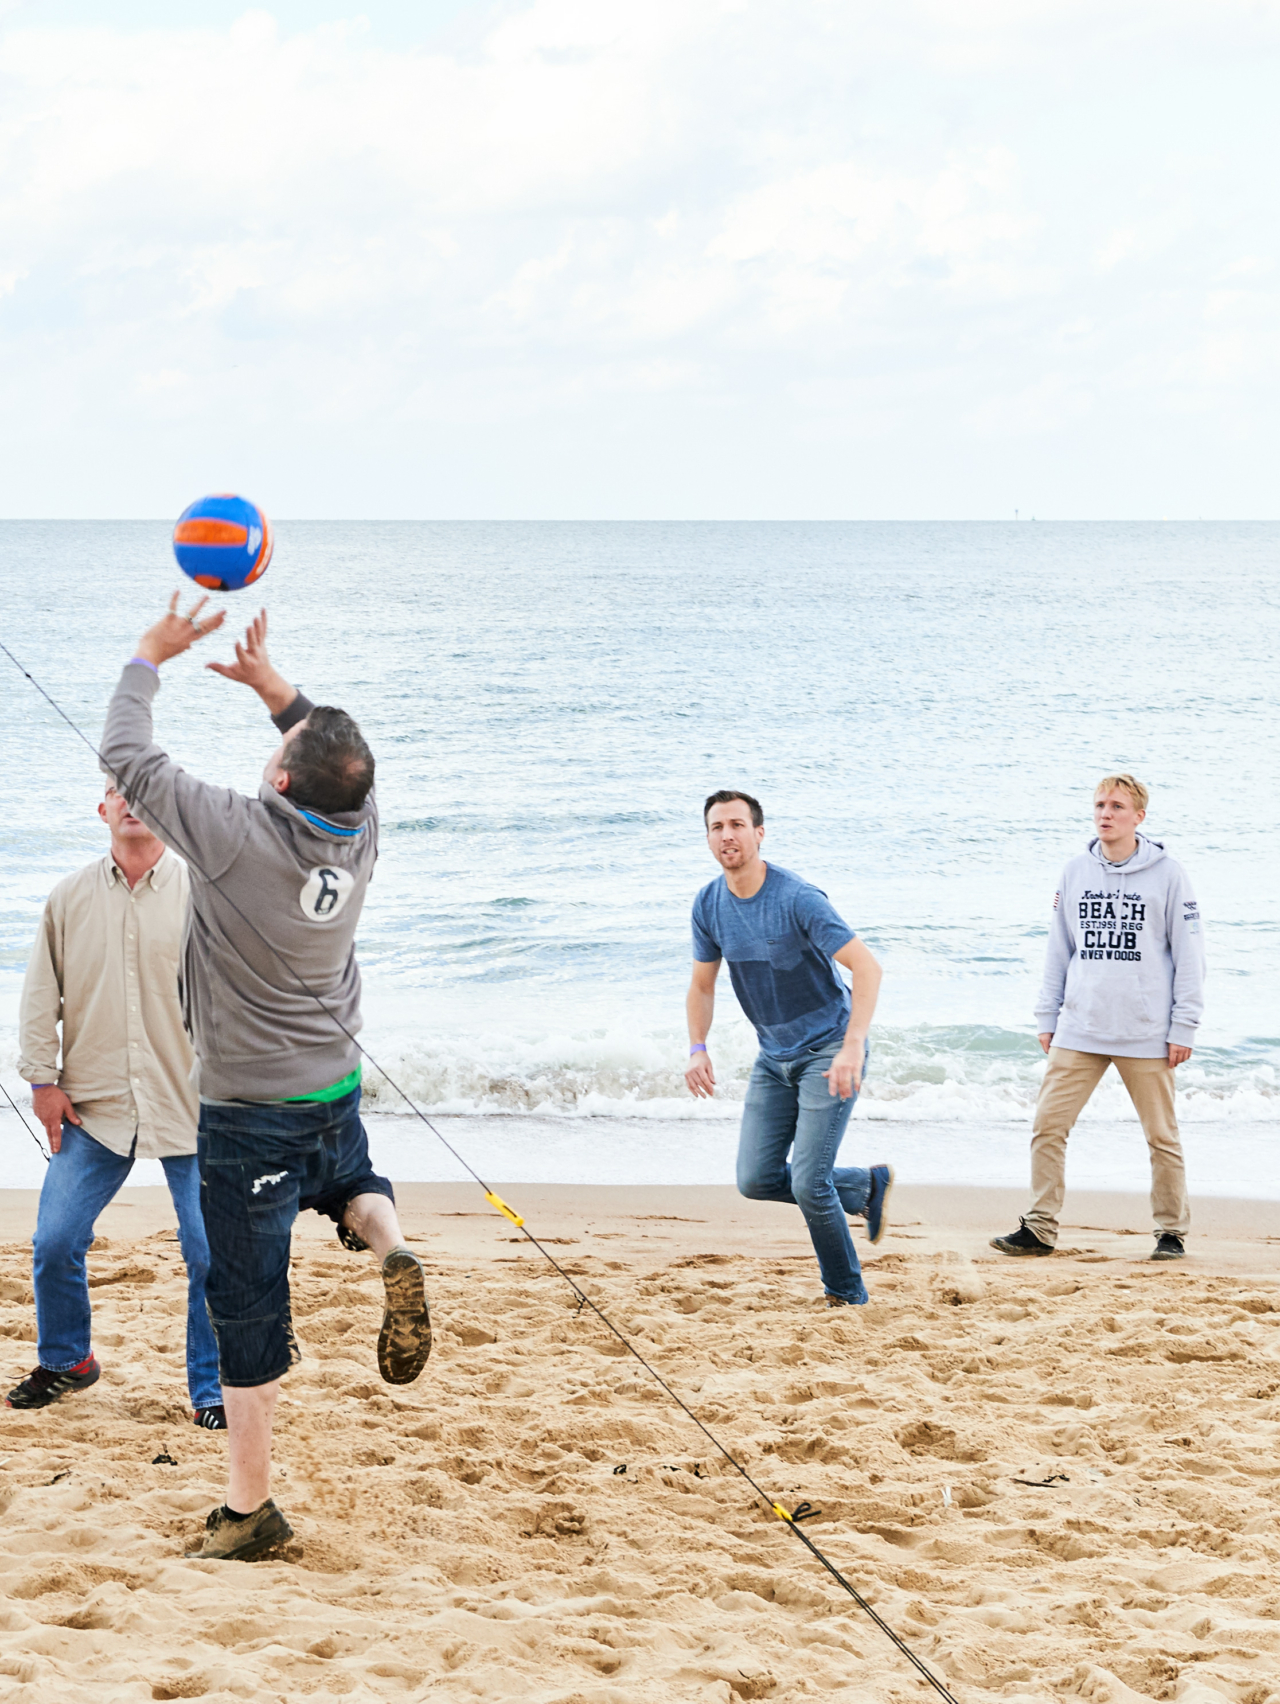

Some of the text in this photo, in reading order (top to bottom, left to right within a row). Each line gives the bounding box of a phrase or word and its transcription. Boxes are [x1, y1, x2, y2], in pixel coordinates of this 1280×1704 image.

[314, 868, 339, 915] 6
[1079, 901, 1146, 921] BEACH
[1121, 921, 1143, 931] REG
[1085, 930, 1137, 949] CLUB
